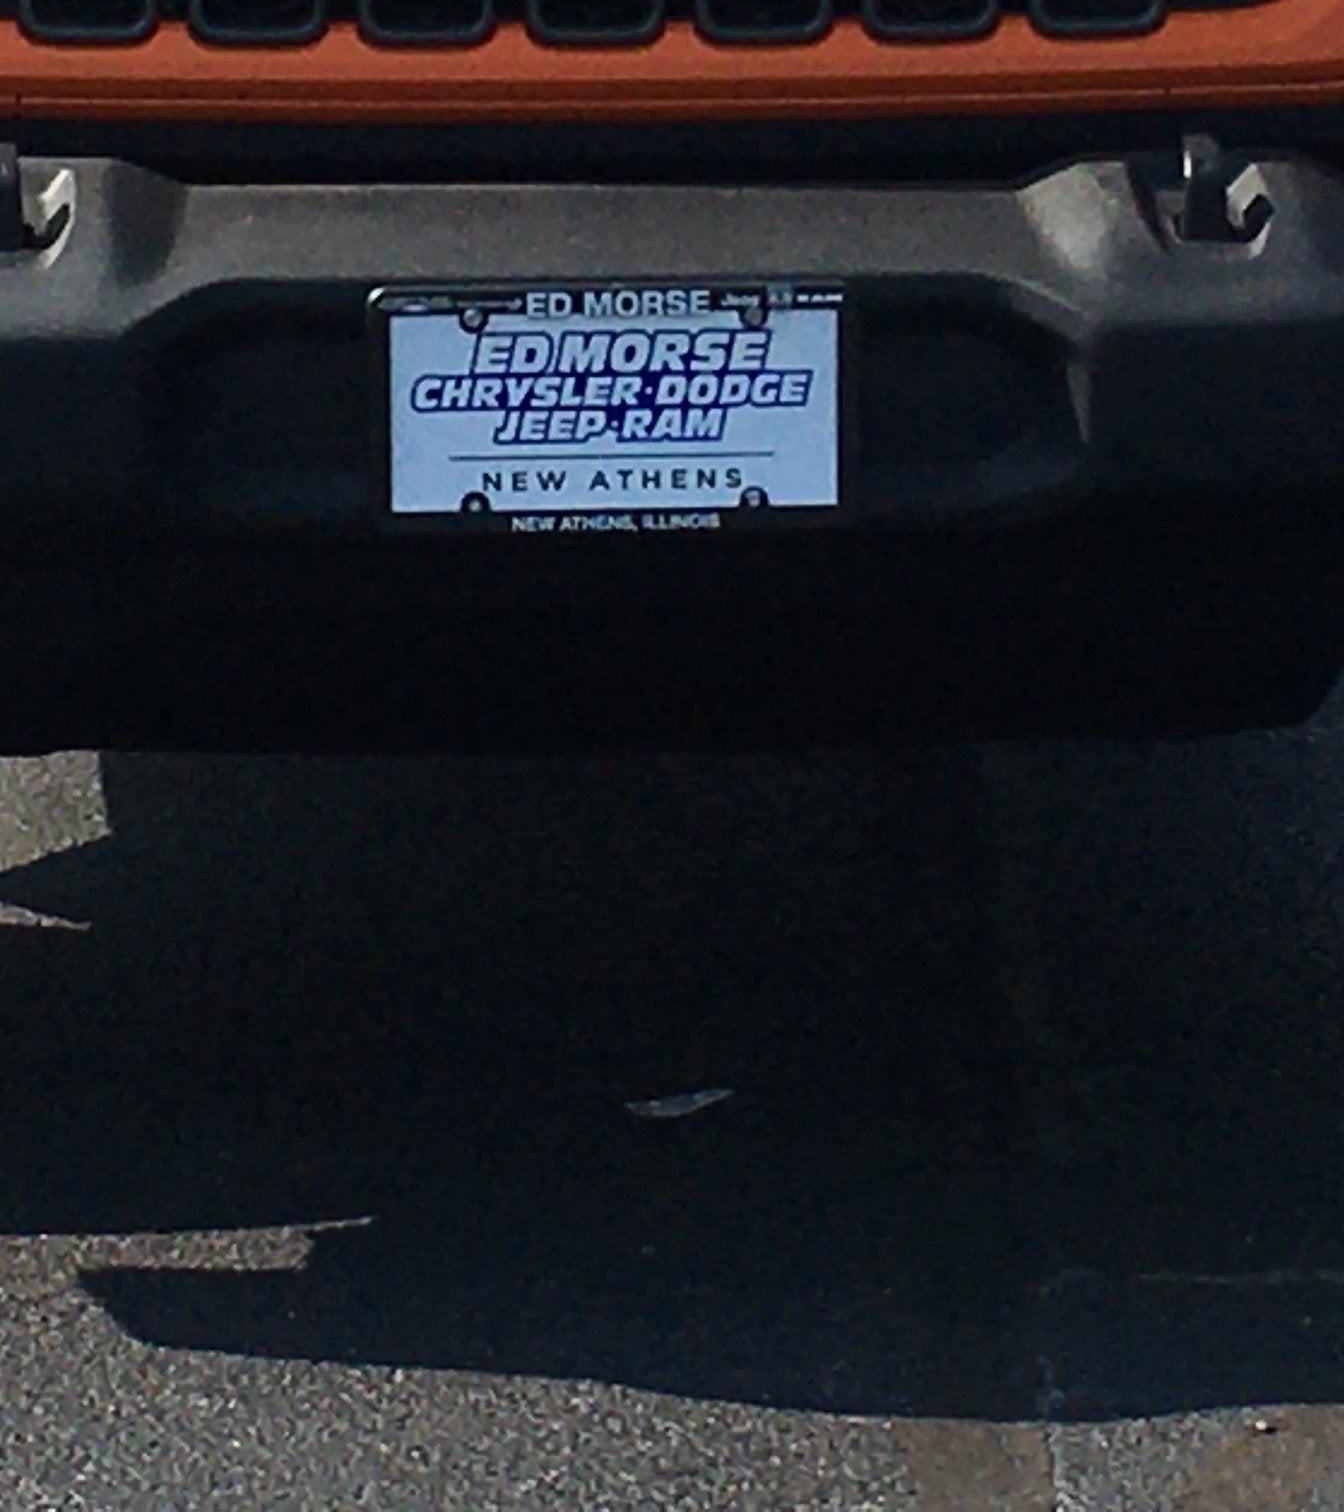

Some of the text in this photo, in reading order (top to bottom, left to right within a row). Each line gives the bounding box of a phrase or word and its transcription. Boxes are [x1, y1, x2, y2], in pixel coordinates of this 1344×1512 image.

[526, 292, 572, 318] ED
[583, 290, 710, 318] MORSE
[472, 331, 769, 373] ED MORSE
[482, 468, 743, 491] NEW ATHENS
[511, 516, 556, 532] NEW
